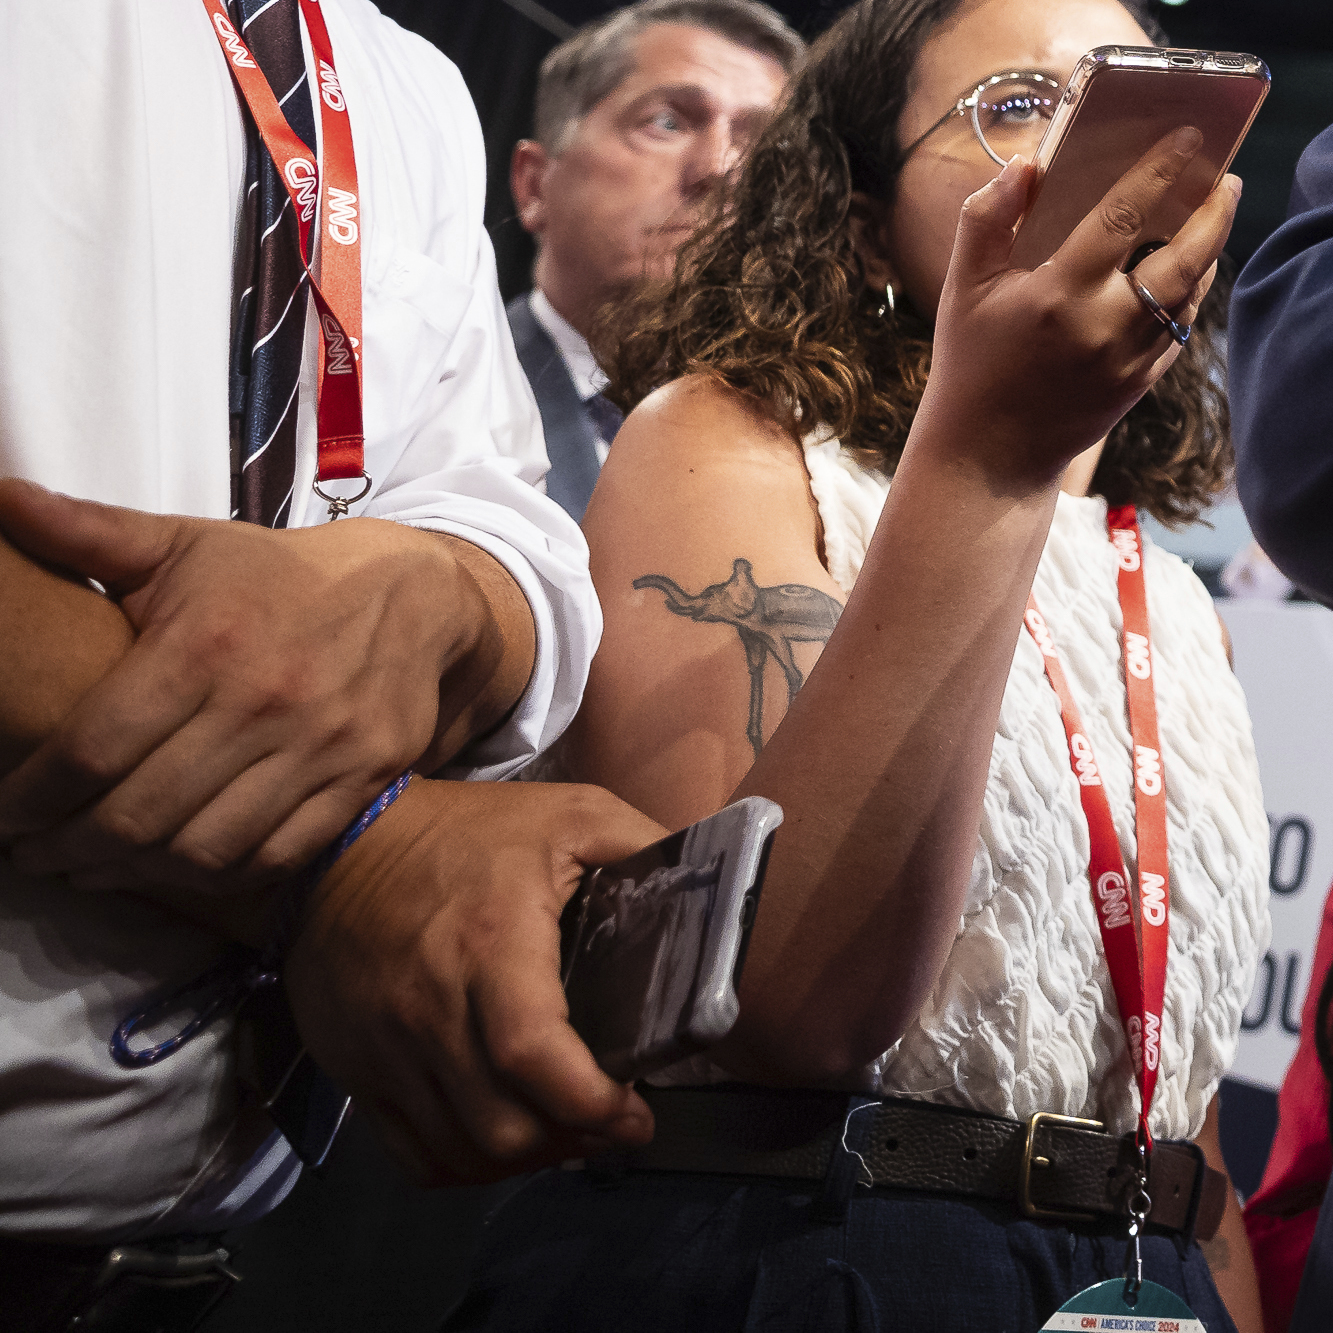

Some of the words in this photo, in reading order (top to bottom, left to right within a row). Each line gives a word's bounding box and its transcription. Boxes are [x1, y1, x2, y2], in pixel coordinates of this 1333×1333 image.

[213, 12, 256, 69] CNN
[319, 59, 346, 112] CNN
[284, 157, 317, 223] CNN
[327, 186, 358, 246] CNN
[321, 312, 353, 375] CNN
[1111, 528, 1142, 572] CNN
[1026, 608, 1058, 658] CNN
[1124, 631, 1152, 680] CNN
[1070, 732, 1102, 787] CNN
[1134, 744, 1163, 797] CNN
[1097, 871, 1132, 930] CNN
[1141, 871, 1167, 928] CNN
[1143, 1010, 1160, 1072] CNN
[1080, 1316, 1097, 1329] CNN
[1100, 1318, 1134, 1331] AMERICA'S
[1135, 1319, 1157, 1332] CHOICE
[1158, 1321, 1180, 1332] 2024
